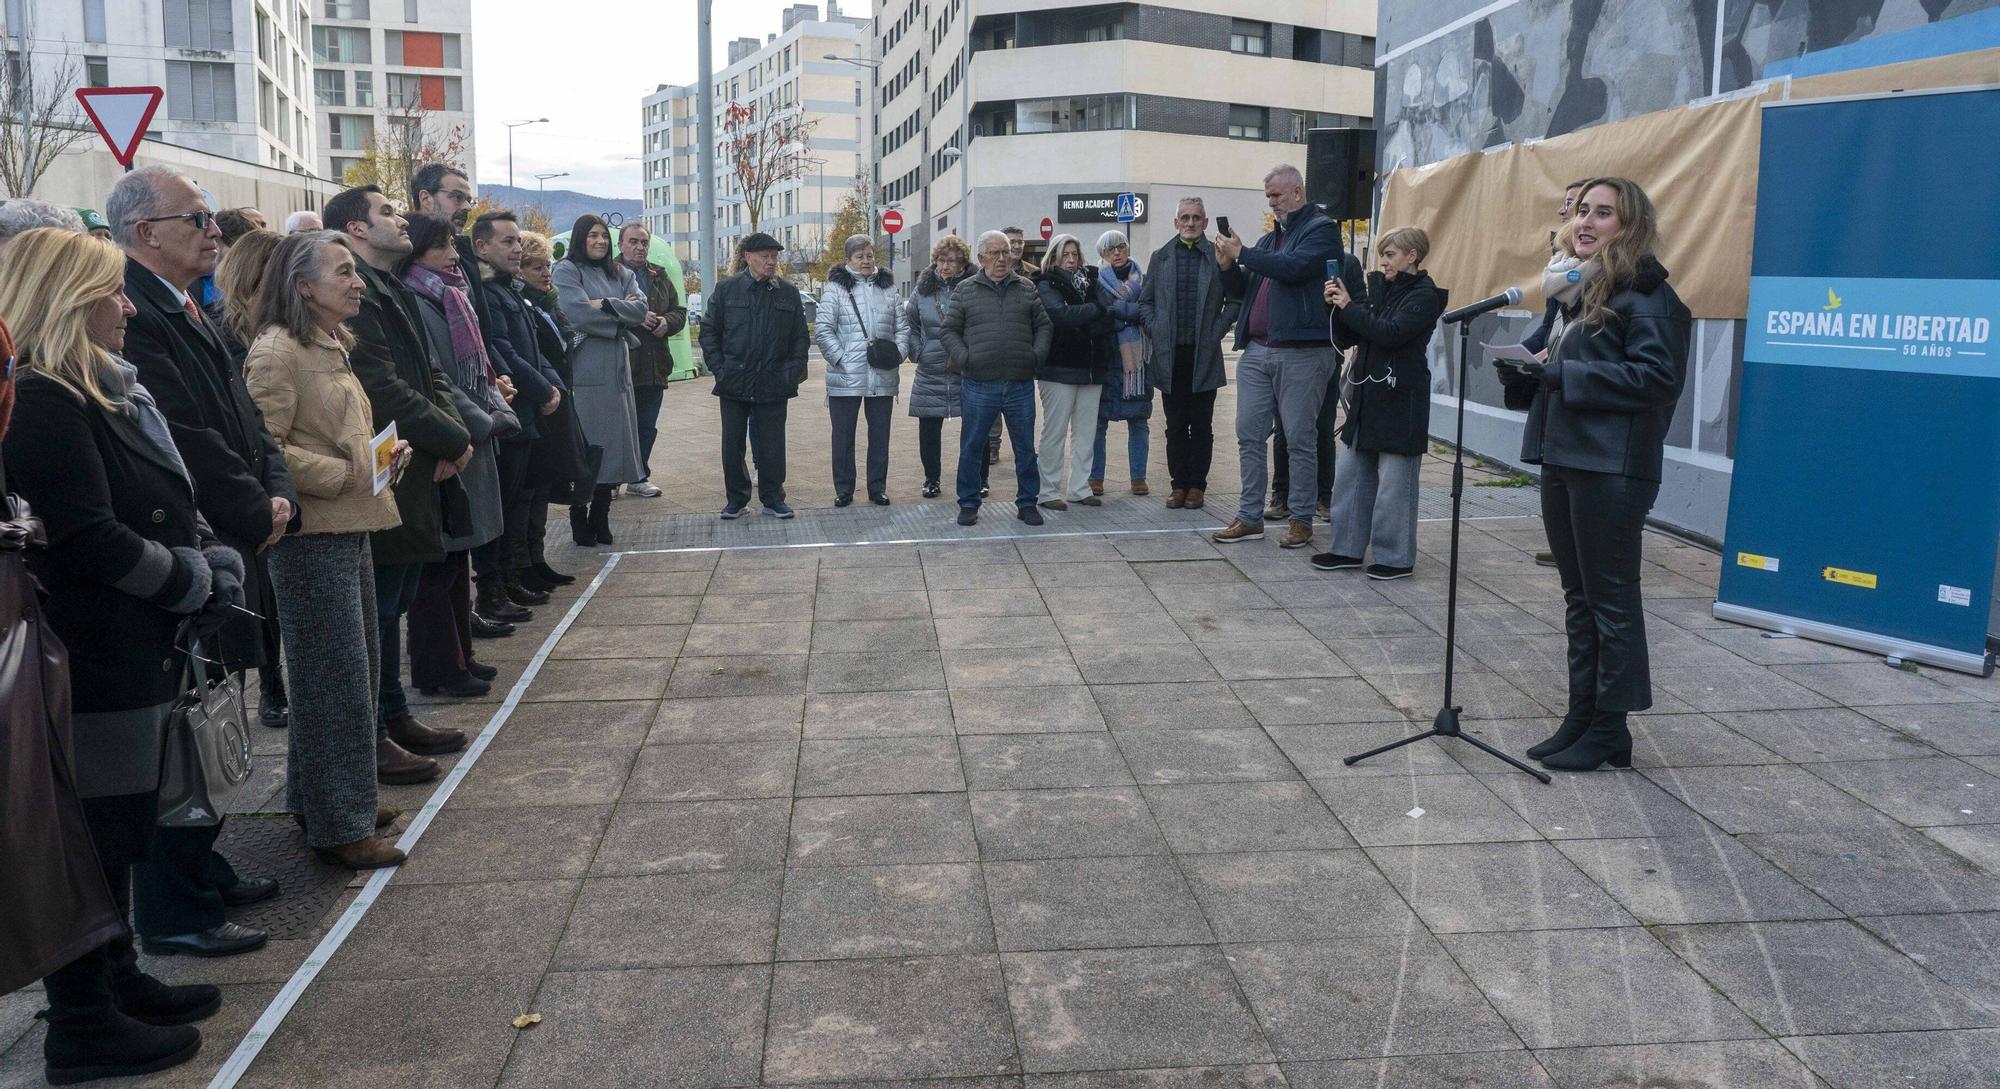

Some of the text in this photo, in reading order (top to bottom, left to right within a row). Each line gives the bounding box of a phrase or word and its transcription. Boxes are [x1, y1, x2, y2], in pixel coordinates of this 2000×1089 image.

[1063, 199, 1115, 209] HENKO ACADEMY
[1848, 313, 1877, 338] EN
[1881, 314, 1990, 344] LIBERTAD
[1902, 344, 1952, 357] 50 AÑOS
